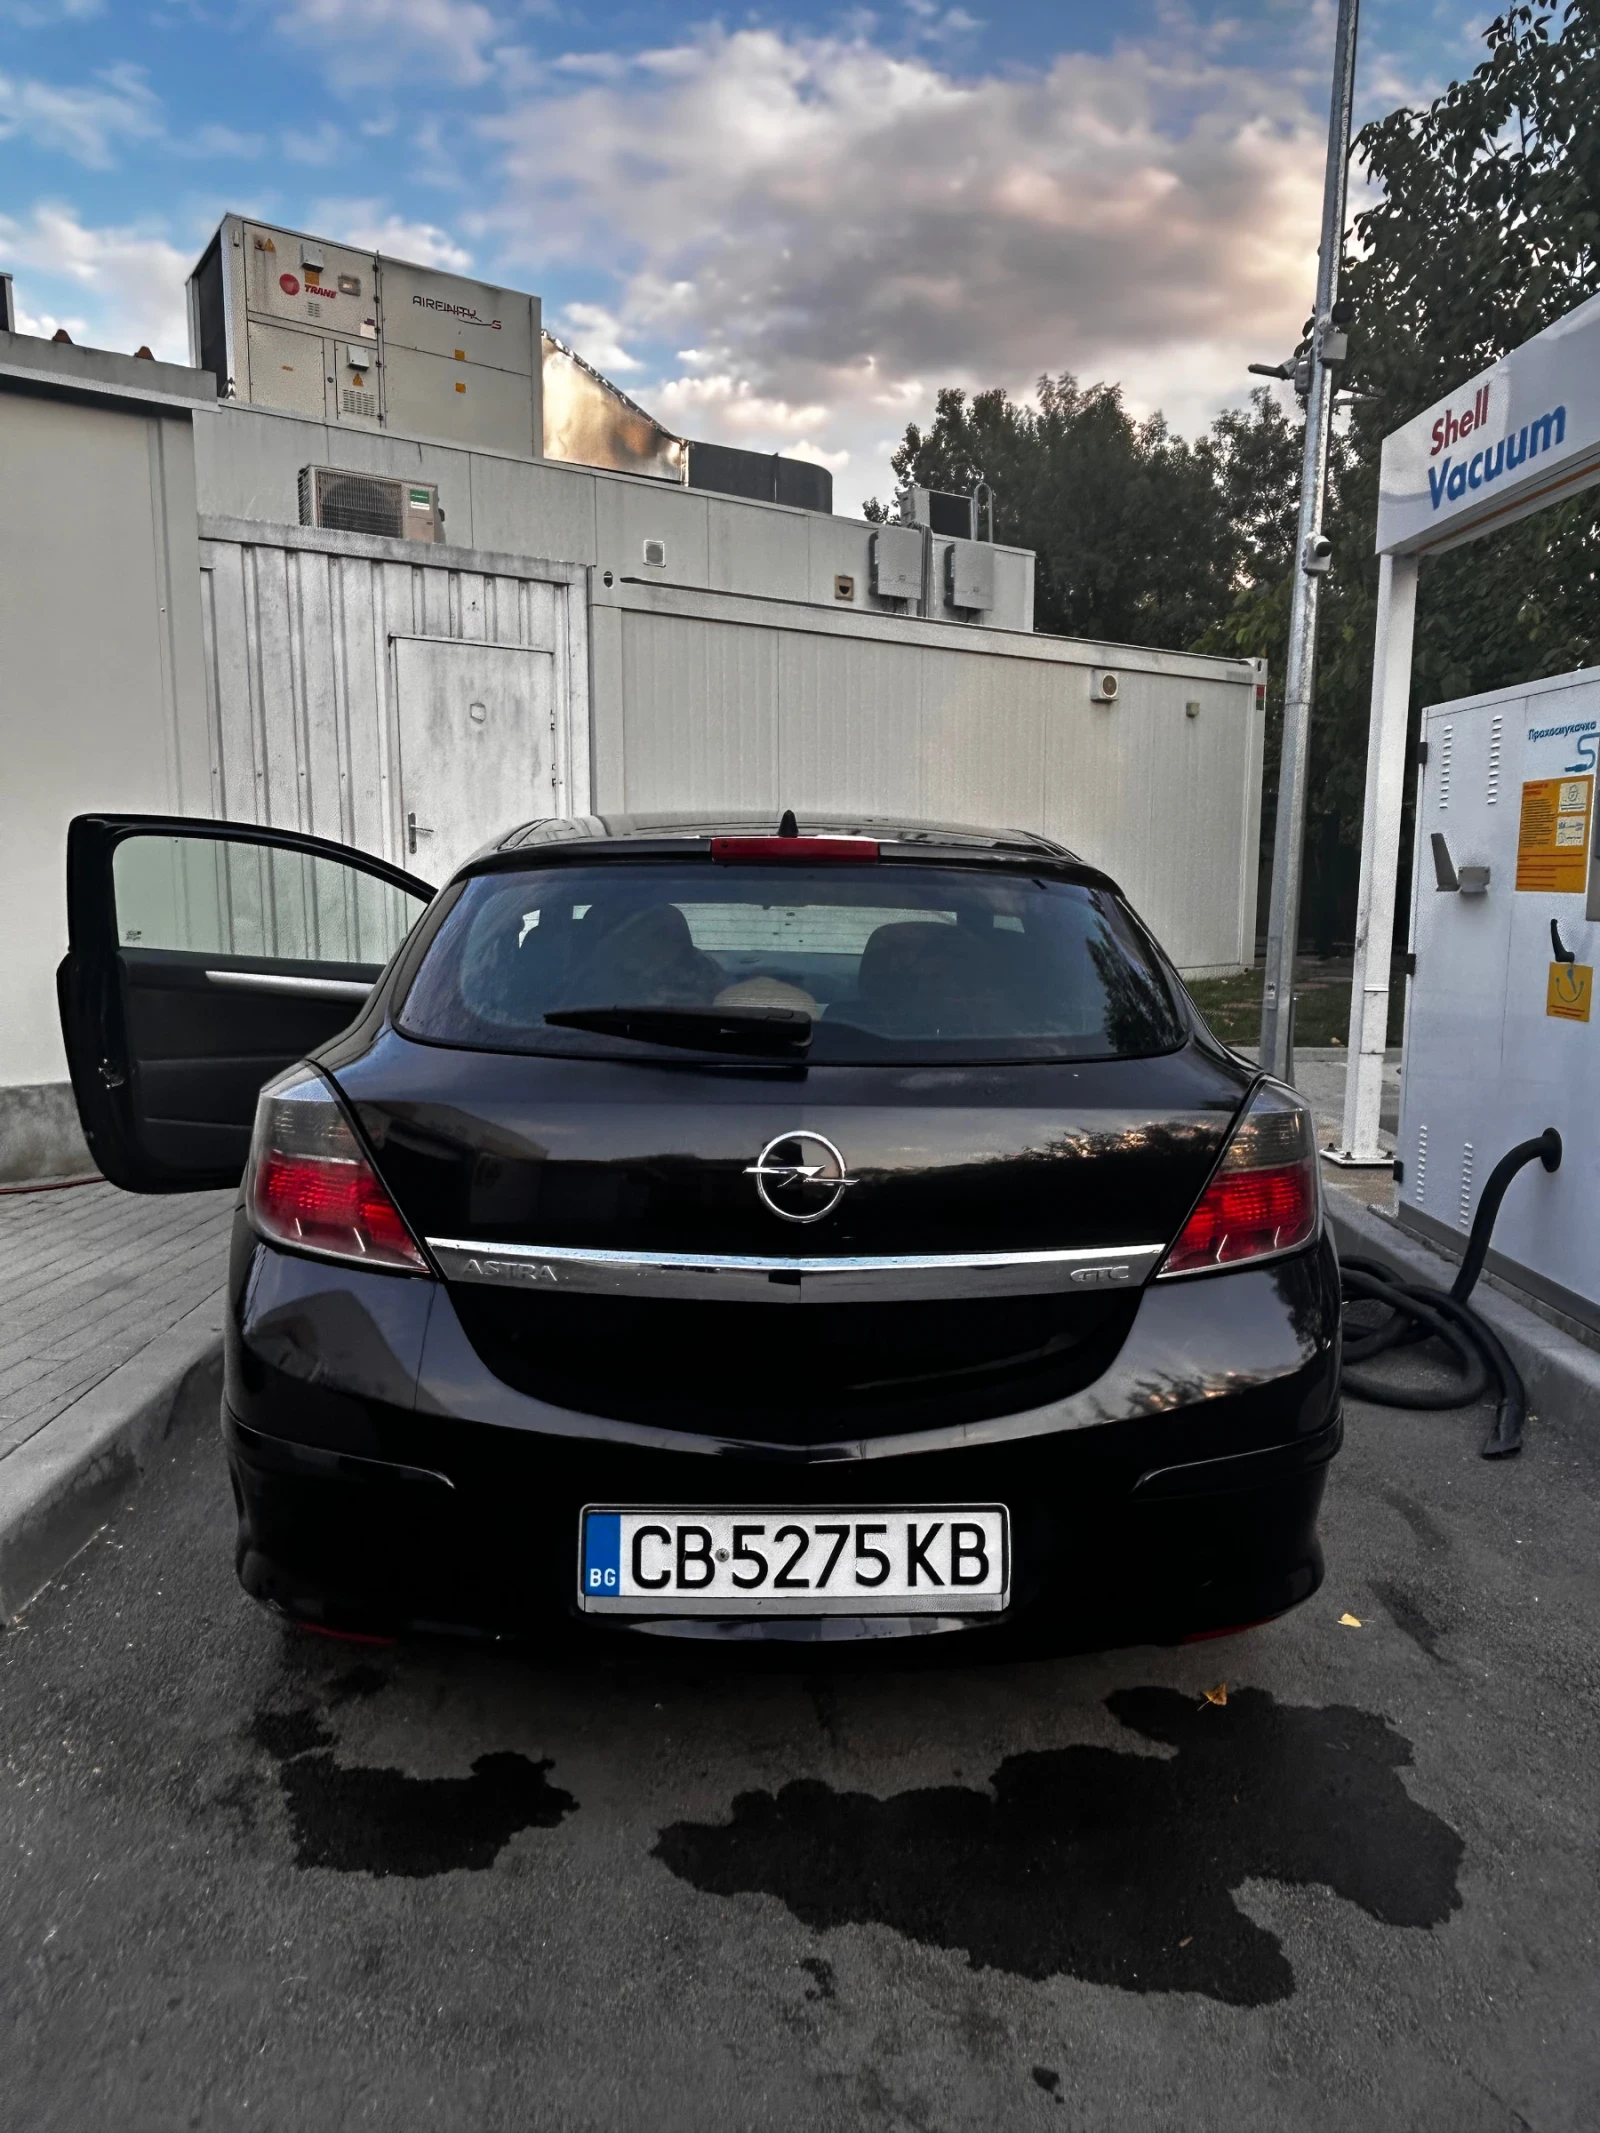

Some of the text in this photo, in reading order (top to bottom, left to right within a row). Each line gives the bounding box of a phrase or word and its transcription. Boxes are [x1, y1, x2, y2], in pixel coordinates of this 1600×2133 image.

[304, 283, 337, 299] TRANE
[412, 295, 502, 330] AIRFINITY S
[1430, 383, 1490, 456] Shell
[1428, 405, 1566, 510] Vacuum
[462, 1258, 558, 1281] ASTRA
[1070, 1265, 1130, 1282] GTC
[631, 1522, 990, 1590] CB 5275 KB
[589, 1568, 617, 1587] BG
